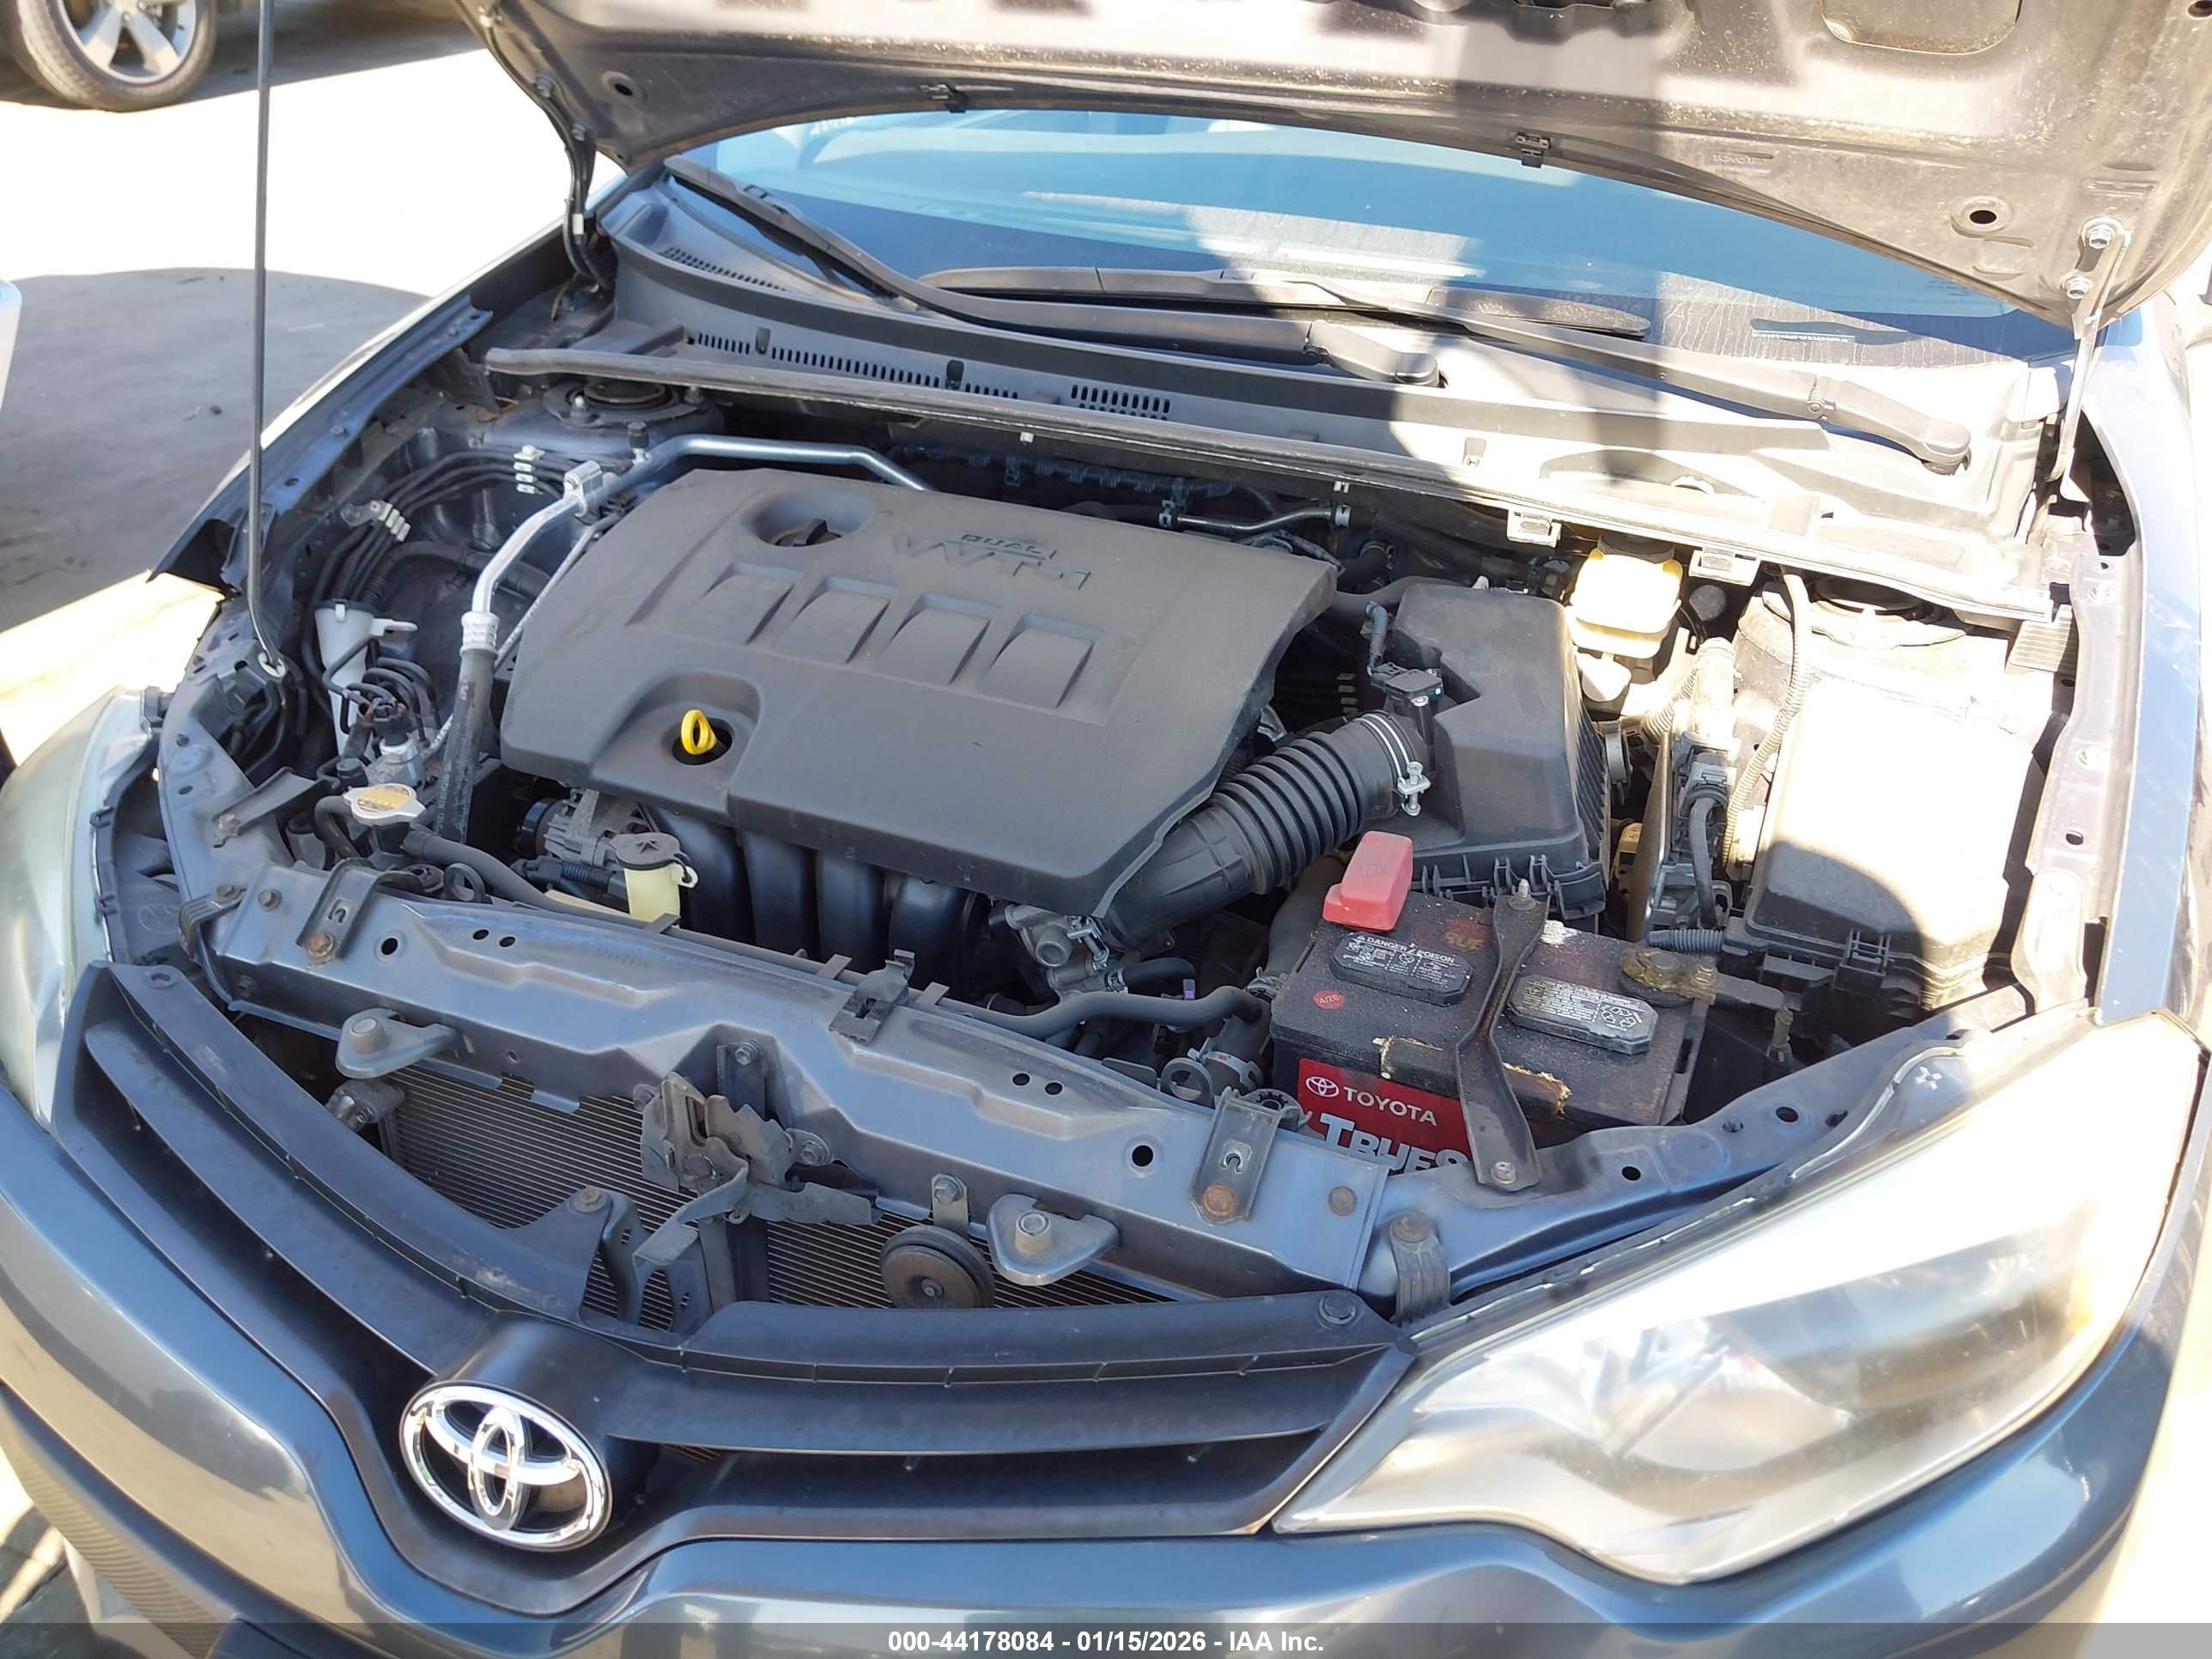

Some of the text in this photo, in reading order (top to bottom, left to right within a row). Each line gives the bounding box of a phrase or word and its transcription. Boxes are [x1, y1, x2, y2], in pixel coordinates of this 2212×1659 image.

[1366, 936, 1455, 963] DANGER POISON
[1343, 1085, 1437, 1127] TOYOTA
